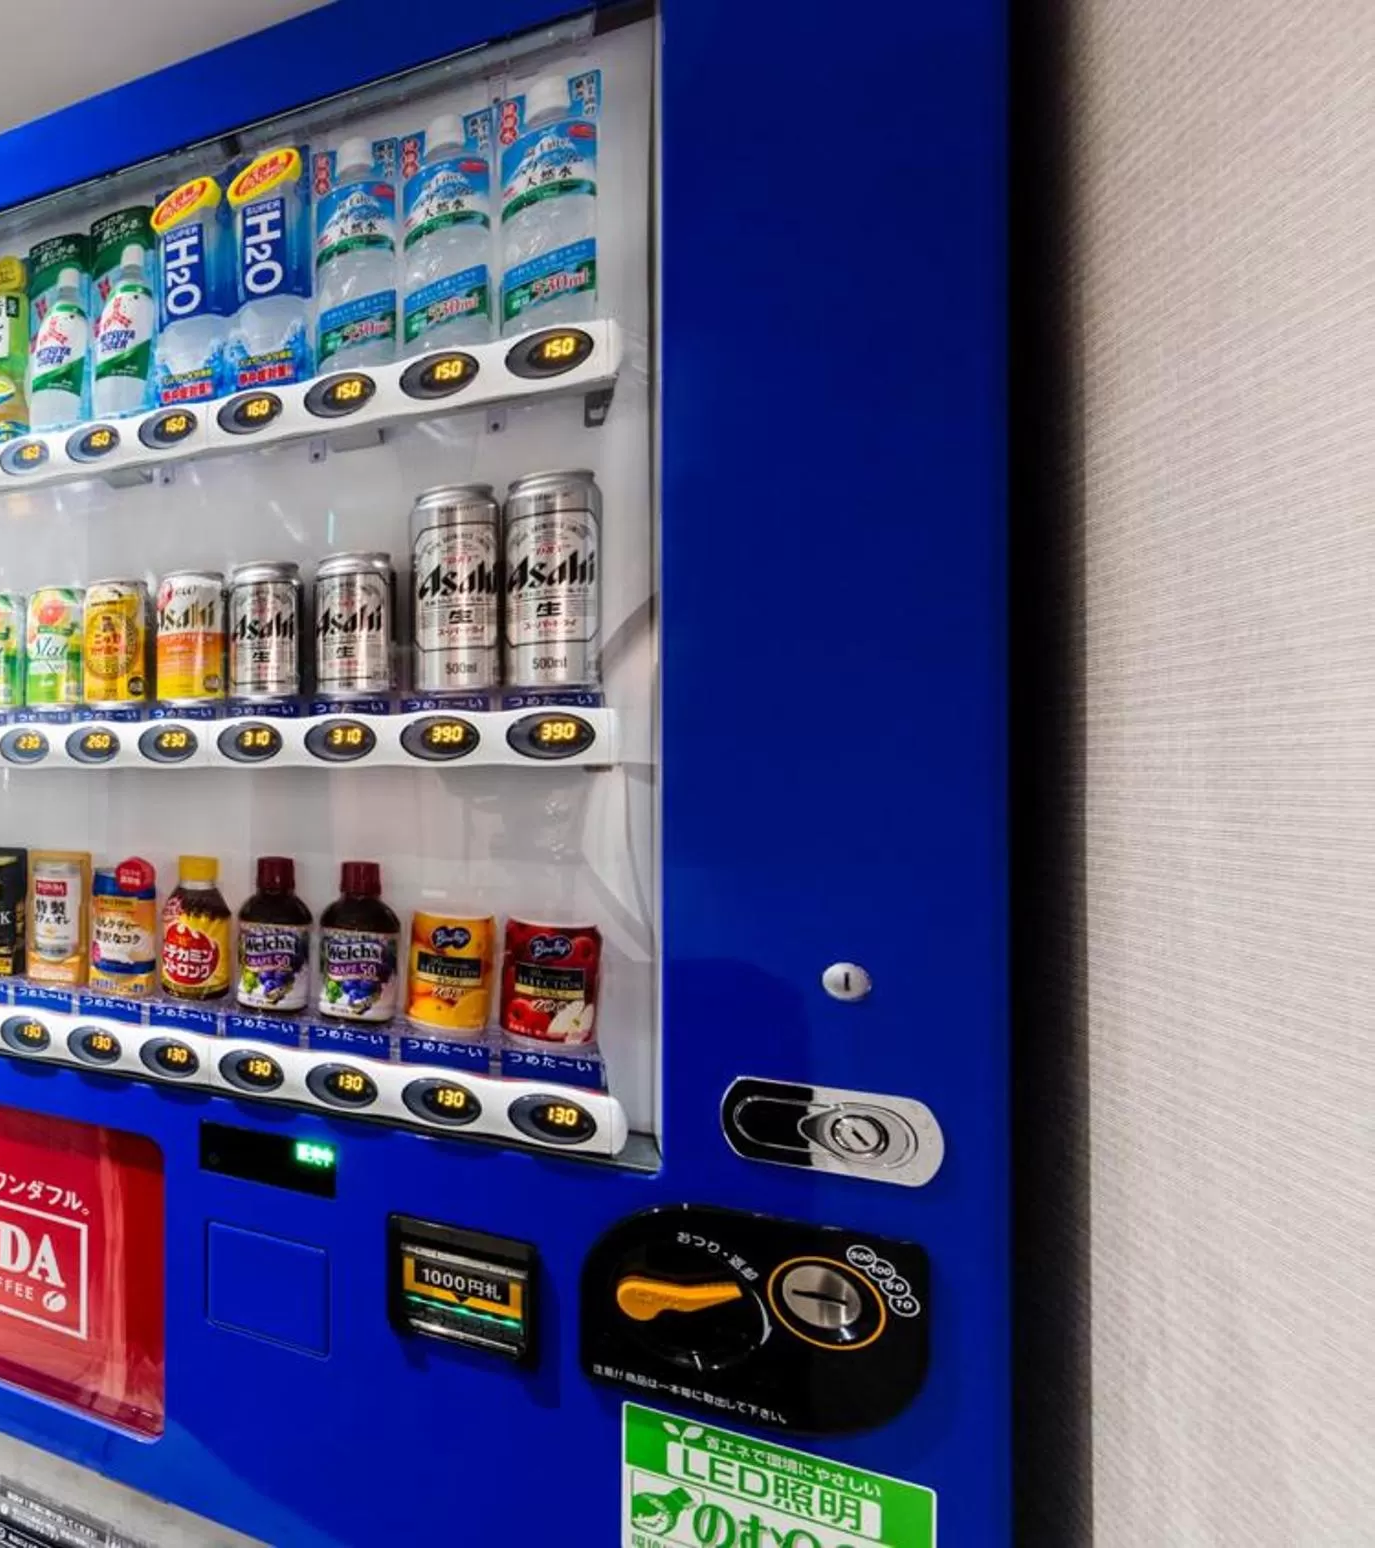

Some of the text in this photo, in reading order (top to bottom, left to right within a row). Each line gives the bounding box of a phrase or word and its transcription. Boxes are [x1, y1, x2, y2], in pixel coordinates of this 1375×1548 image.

[544, 336, 577, 358] 150
[434, 359, 464, 380] 150
[335, 380, 362, 400] 150
[506, 549, 595, 593] Asahi
[536, 601, 561, 617] 生
[231, 610, 295, 642] Asahi
[315, 604, 382, 638] Asahi
[252, 650, 271, 663] 生
[335, 645, 355, 659] 生
[161, 732, 187, 748] 230
[243, 730, 271, 746] 310
[332, 728, 362, 745] 310
[431, 725, 464, 743] 390
[540, 721, 576, 740] 390
[91, 1035, 113, 1051] 130
[167, 1046, 189, 1063] 130
[248, 1058, 272, 1077] 130
[337, 1072, 364, 1092] 130
[437, 1088, 466, 1109] 130
[547, 1106, 579, 1127] 130
[421, 1267, 502, 1301] 1000円札
[703, 1434, 882, 1498] 省エネで環境にやさしい
[681, 1447, 862, 1532] LED照明
